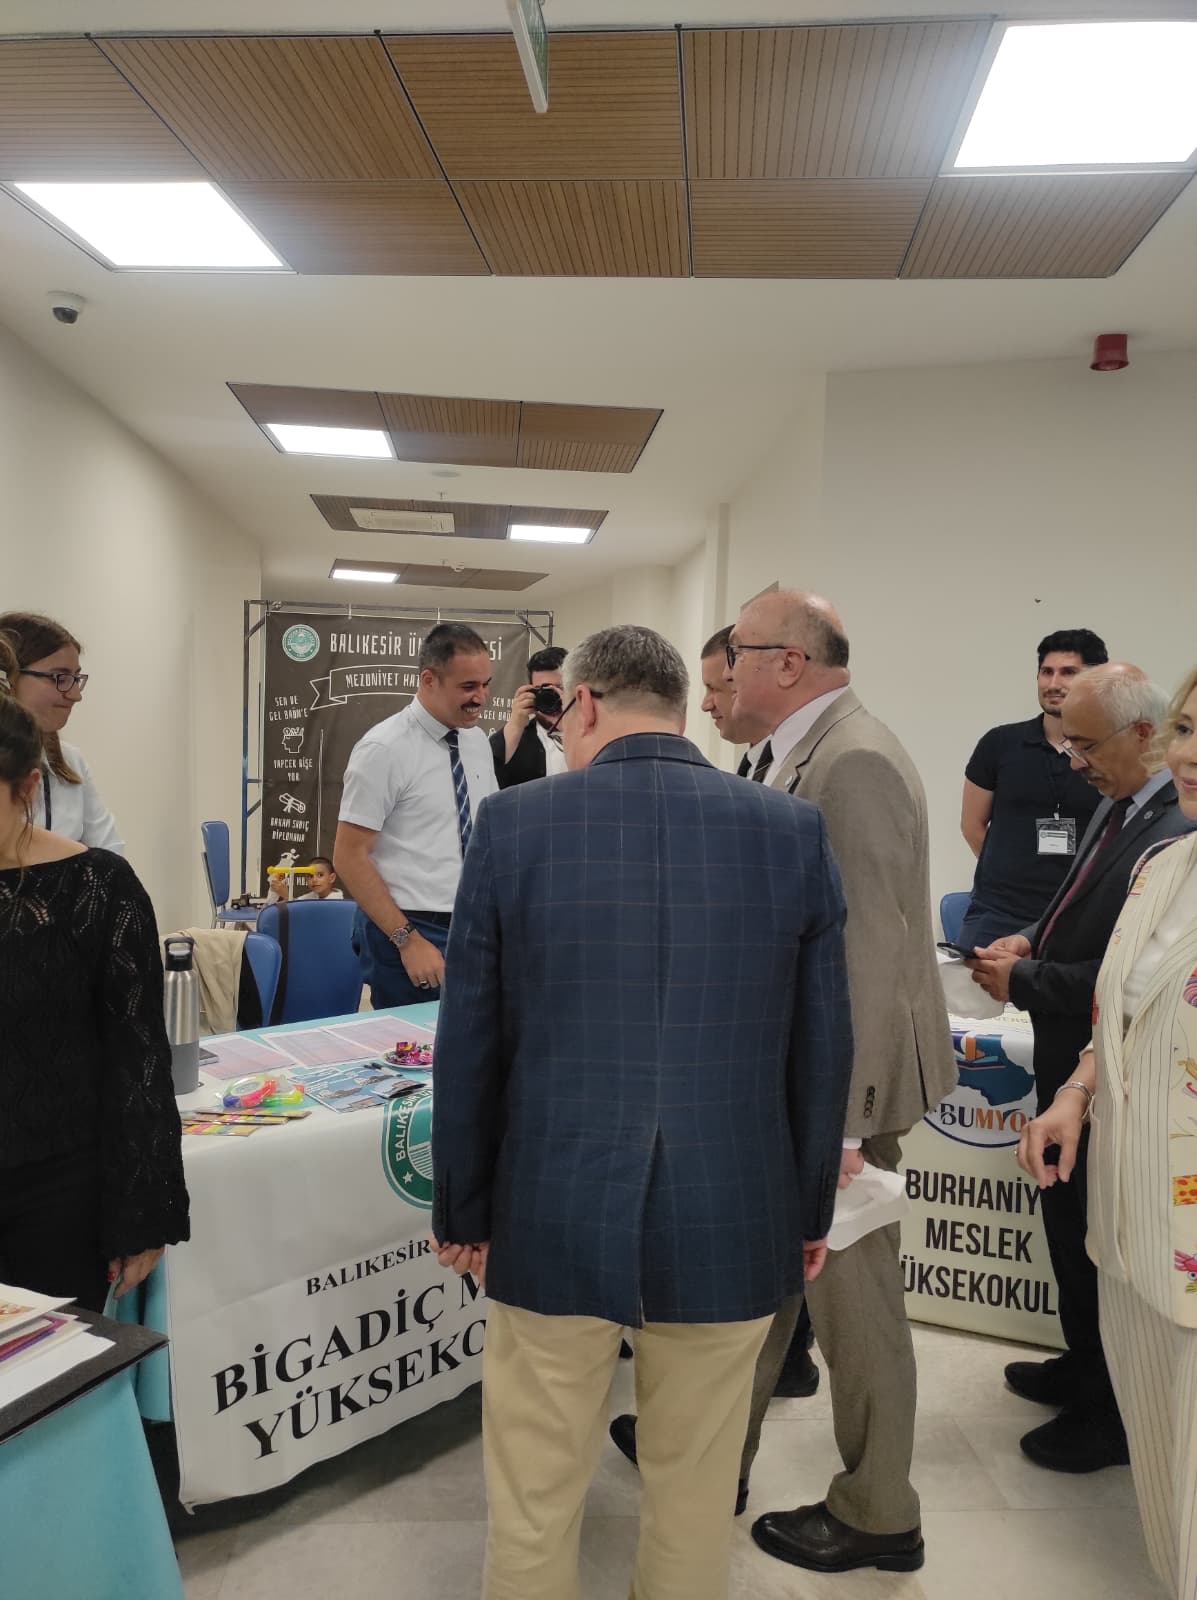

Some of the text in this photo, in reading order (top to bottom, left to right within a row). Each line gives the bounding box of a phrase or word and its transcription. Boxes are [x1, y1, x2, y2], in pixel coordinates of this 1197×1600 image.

[330, 632, 401, 655] BALIKESİR
[345, 670, 398, 688] MEZUNİYET
[940, 1103, 1027, 1133] BUMYO
[905, 1168, 1040, 1216] BURHANİY
[925, 1217, 1033, 1264] MESLEK
[306, 1239, 431, 1297] BALIKESİR
[901, 1254, 1057, 1316] ÜKSEKOKUL
[213, 1284, 445, 1415] BİGADİÇ
